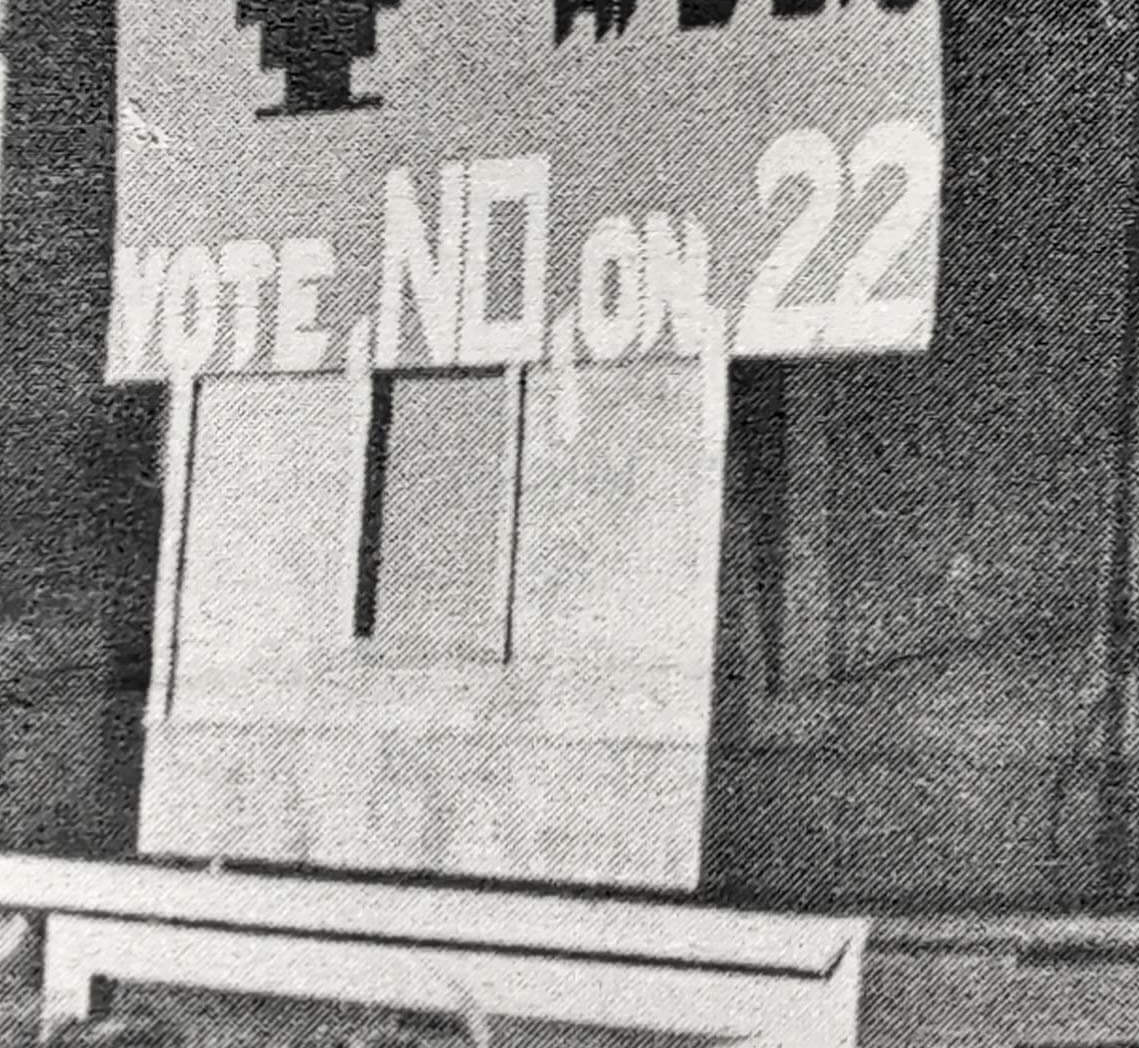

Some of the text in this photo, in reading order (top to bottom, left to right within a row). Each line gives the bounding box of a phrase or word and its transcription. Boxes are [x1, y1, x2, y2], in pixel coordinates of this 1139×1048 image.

[104, 120, 944, 380] VOTE NO ON 22
